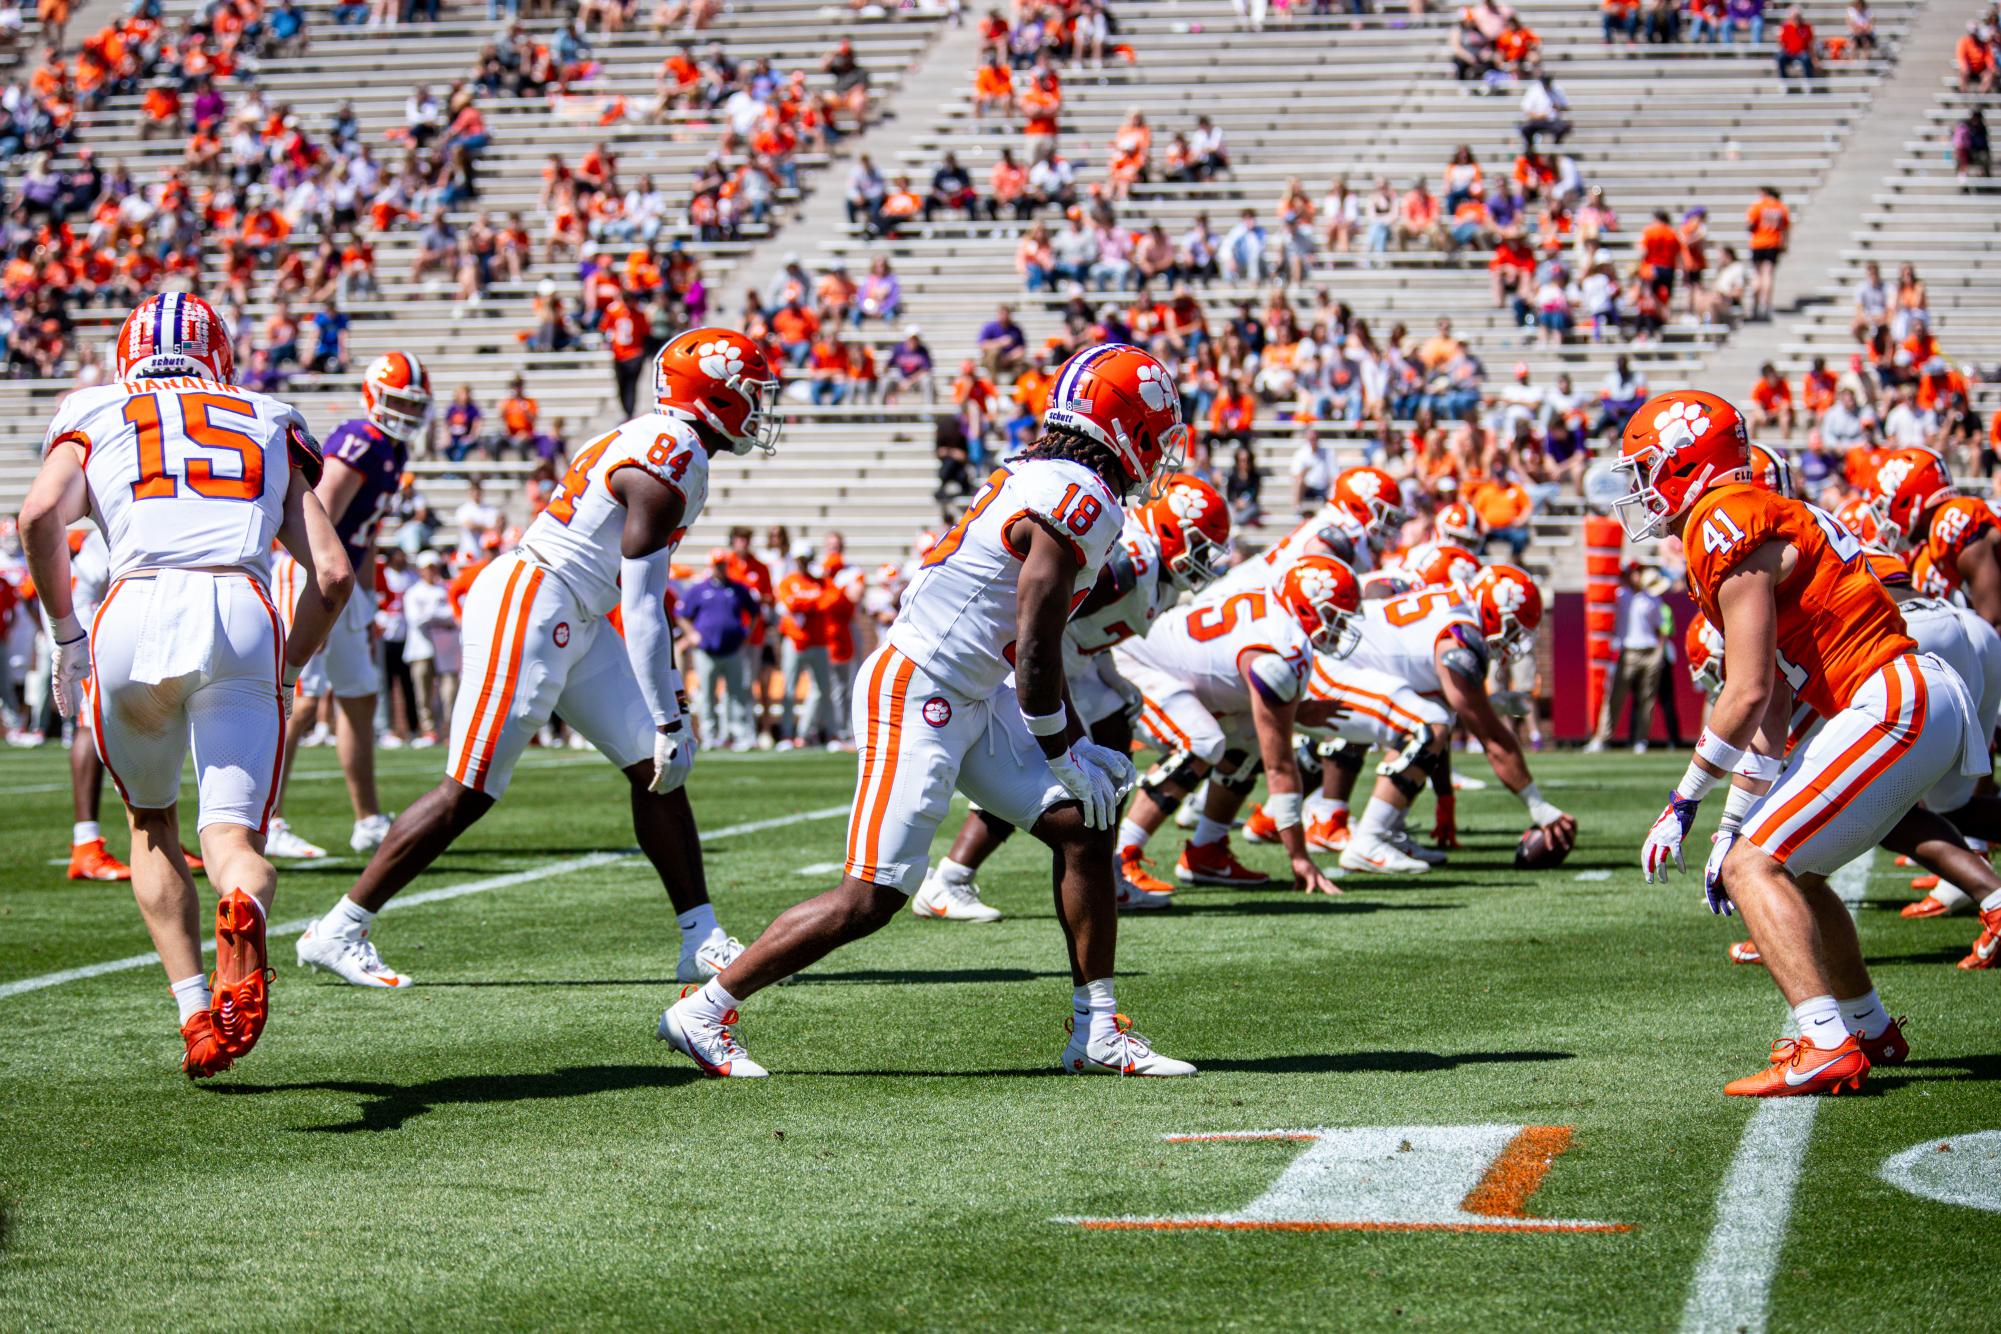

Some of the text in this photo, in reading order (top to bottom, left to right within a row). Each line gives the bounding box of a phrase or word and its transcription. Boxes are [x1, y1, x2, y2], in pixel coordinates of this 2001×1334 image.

[151, 356, 185, 366] schutt
[1048, 410, 1074, 423] schutt
[121, 391, 265, 502] 15
[337, 434, 371, 463] 17
[646, 432, 694, 482] 84
[1052, 483, 1102, 536] 18
[1702, 507, 1746, 555] 41
[1936, 506, 1971, 544] 22
